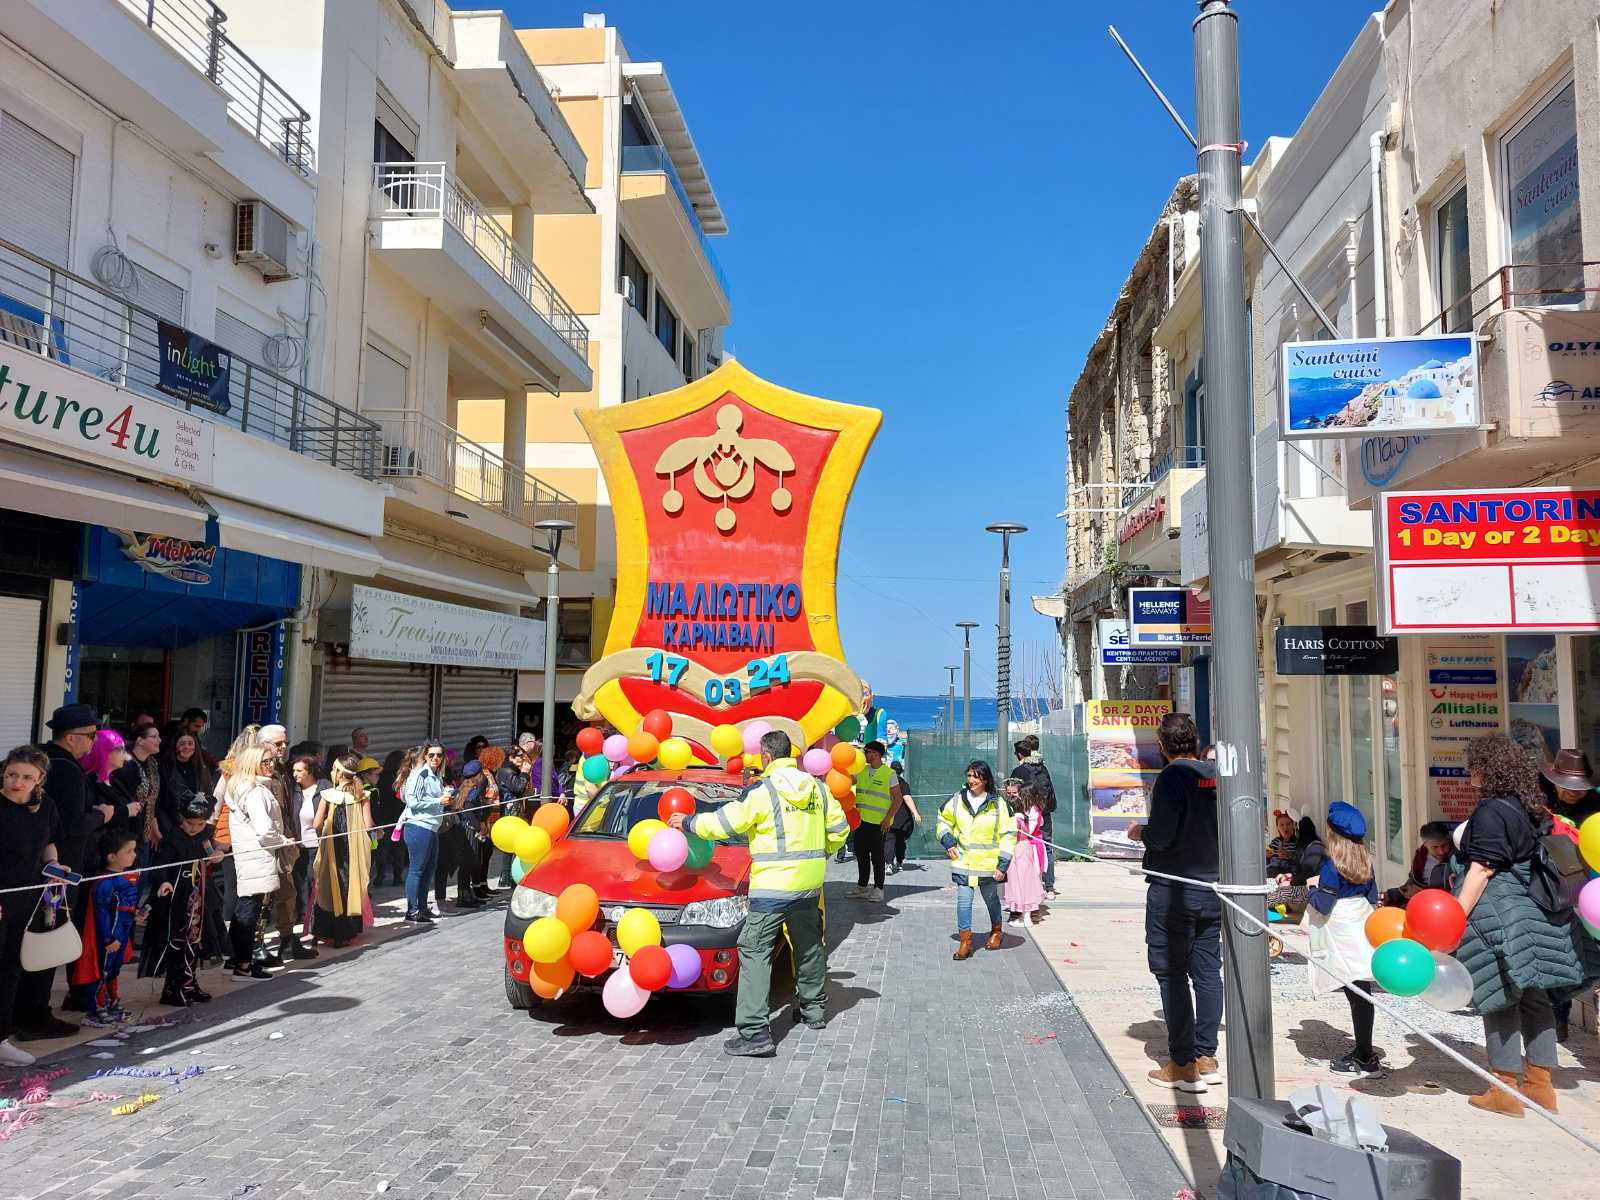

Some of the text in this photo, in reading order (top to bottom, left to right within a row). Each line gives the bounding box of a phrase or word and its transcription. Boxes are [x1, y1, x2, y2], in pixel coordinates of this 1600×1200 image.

[167, 342, 218, 379] inlight
[1293, 349, 1380, 366] Santorini
[1333, 365, 1382, 379] cruise
[176, 420, 200, 437] Selected
[176, 432, 193, 447] Greek
[1398, 529, 1411, 546] 1
[1423, 528, 1477, 549] Day
[1484, 530, 1516, 545] or
[1522, 525, 1541, 544] 2
[646, 582, 802, 622] ΜΑΛΙΩΤΙΚΟ
[64, 586, 78, 693] LOCION
[379, 607, 469, 647] Treasures
[474, 624, 496, 655] of
[663, 622, 775, 652] ΚΑΡΝΑΒΑΛΙ
[277, 621, 286, 669] AUTO
[1283, 637, 1385, 650] HARIS COTTON
[1440, 655, 1496, 663] OLYMPIC
[248, 631, 272, 721] RENT
[646, 652, 792, 706] 17 03 24
[1450, 689, 1498, 700] Hapag-Lloyd
[1093, 704, 1169, 714] 1 OR 2 DAYS
[1431, 703, 1498, 714] Alitalia
[1449, 719, 1499, 728] Lufthansa
